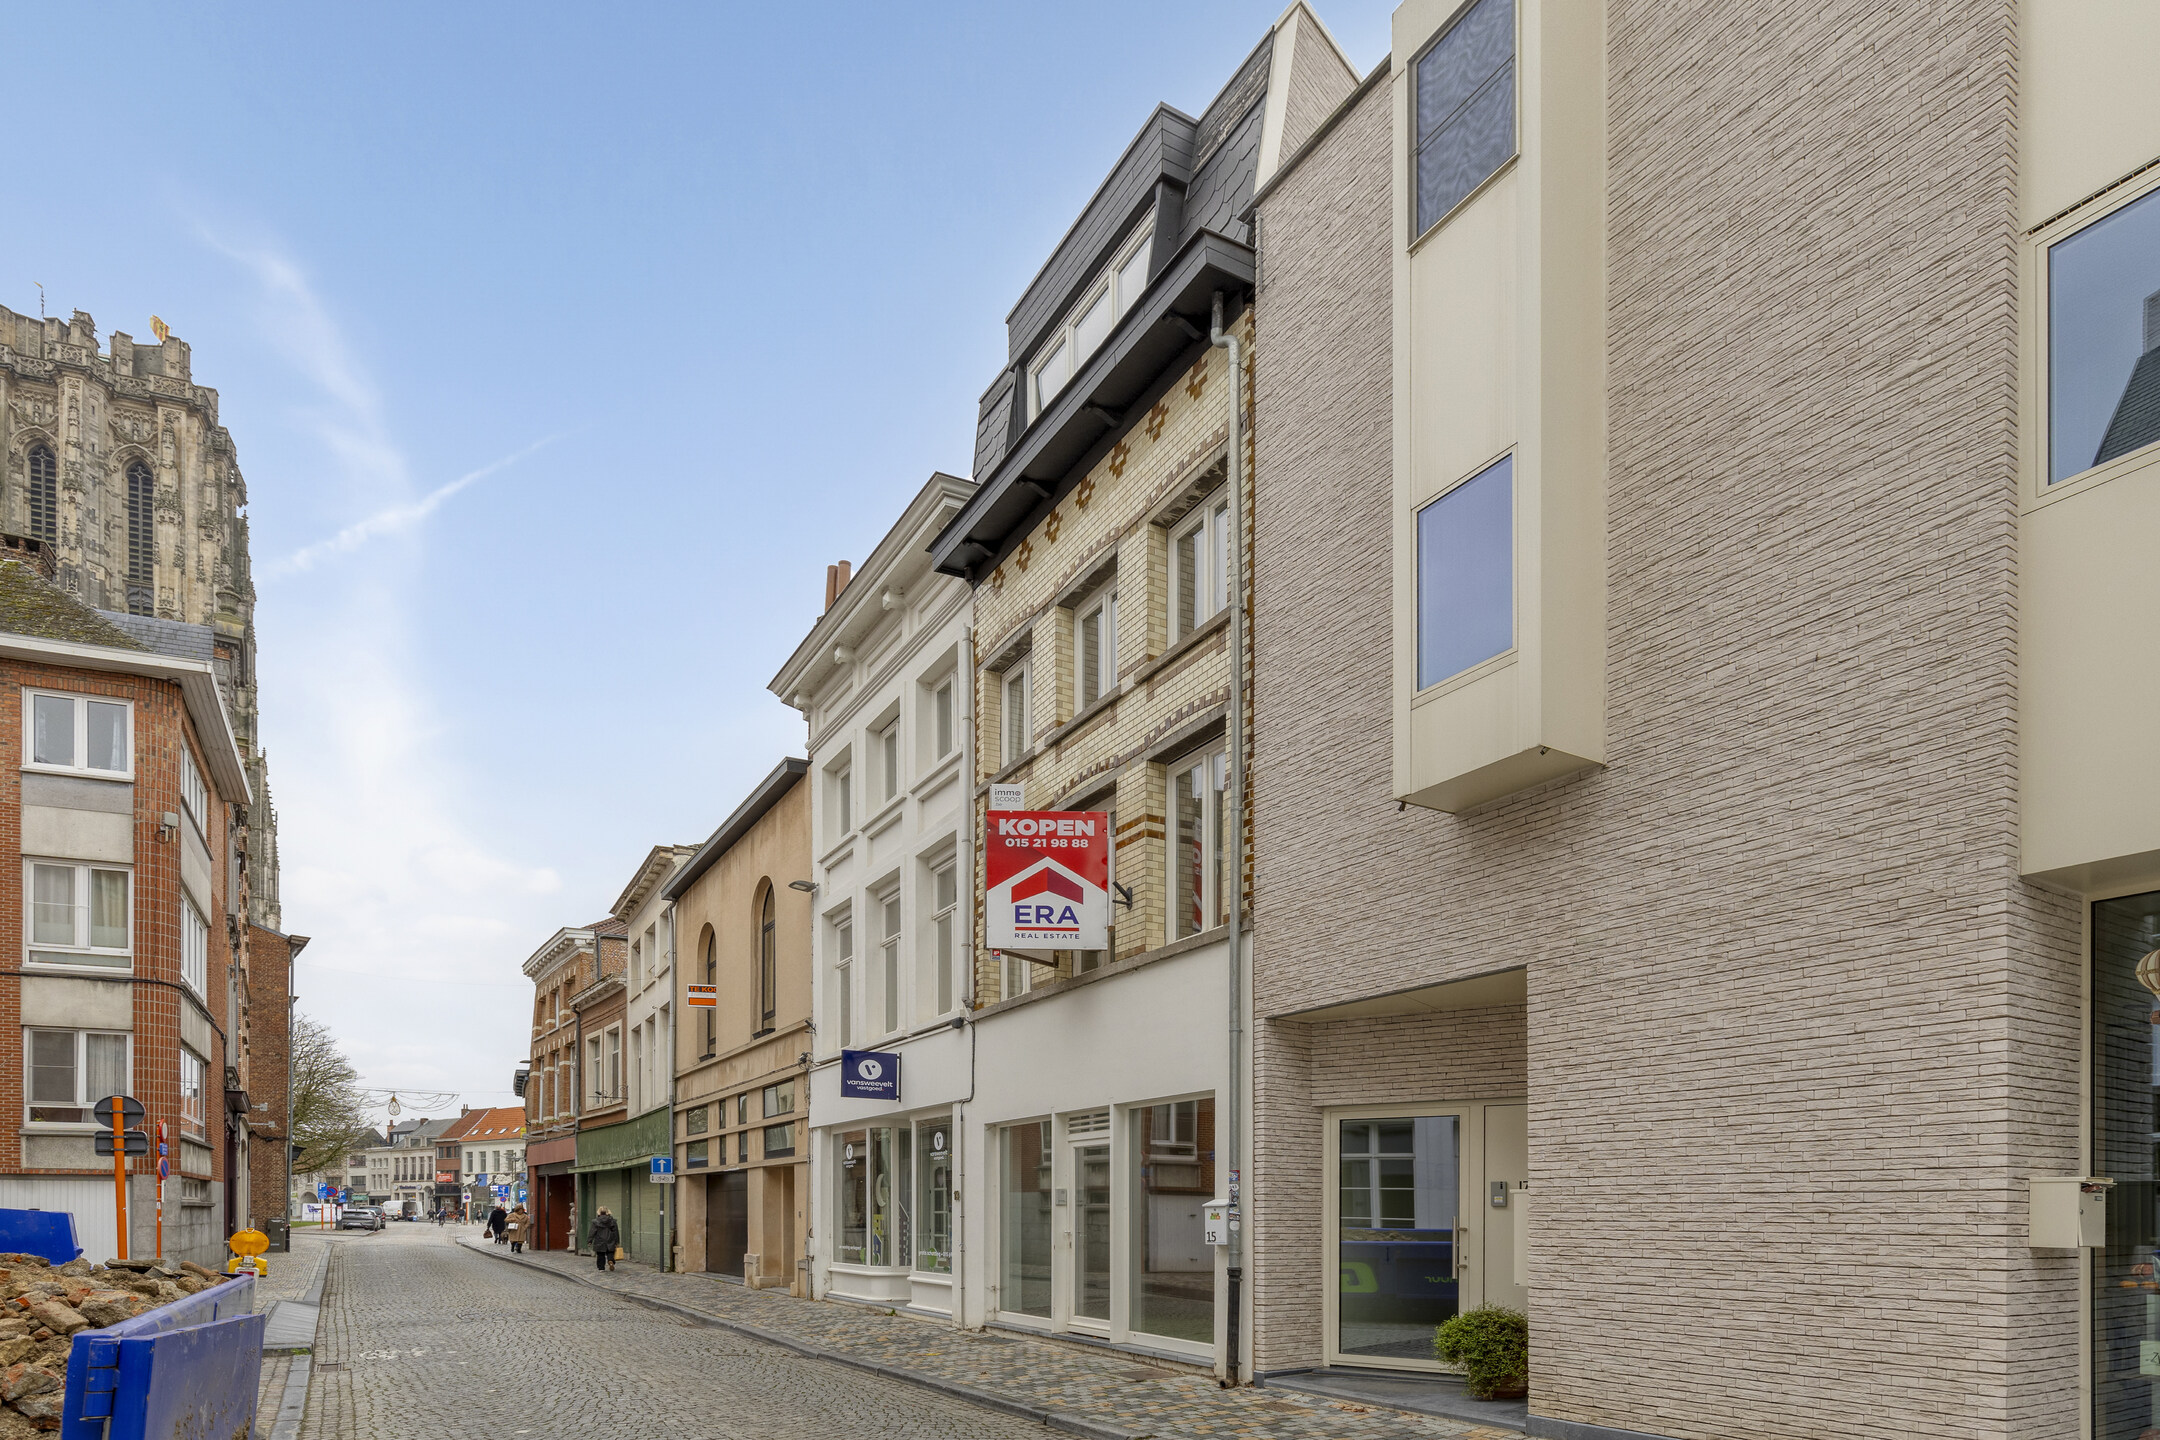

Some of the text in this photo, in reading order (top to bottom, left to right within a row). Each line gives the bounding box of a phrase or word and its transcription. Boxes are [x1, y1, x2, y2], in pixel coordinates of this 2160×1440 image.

[998, 819, 1095, 837] KOPEN
[1005, 838, 1089, 848] 015 21 98 88
[1014, 905, 1080, 925] ERA
[846, 1079, 893, 1088] vansweevelt
[519, 1190, 527, 1198] P
[1206, 1231, 1217, 1243] 15
